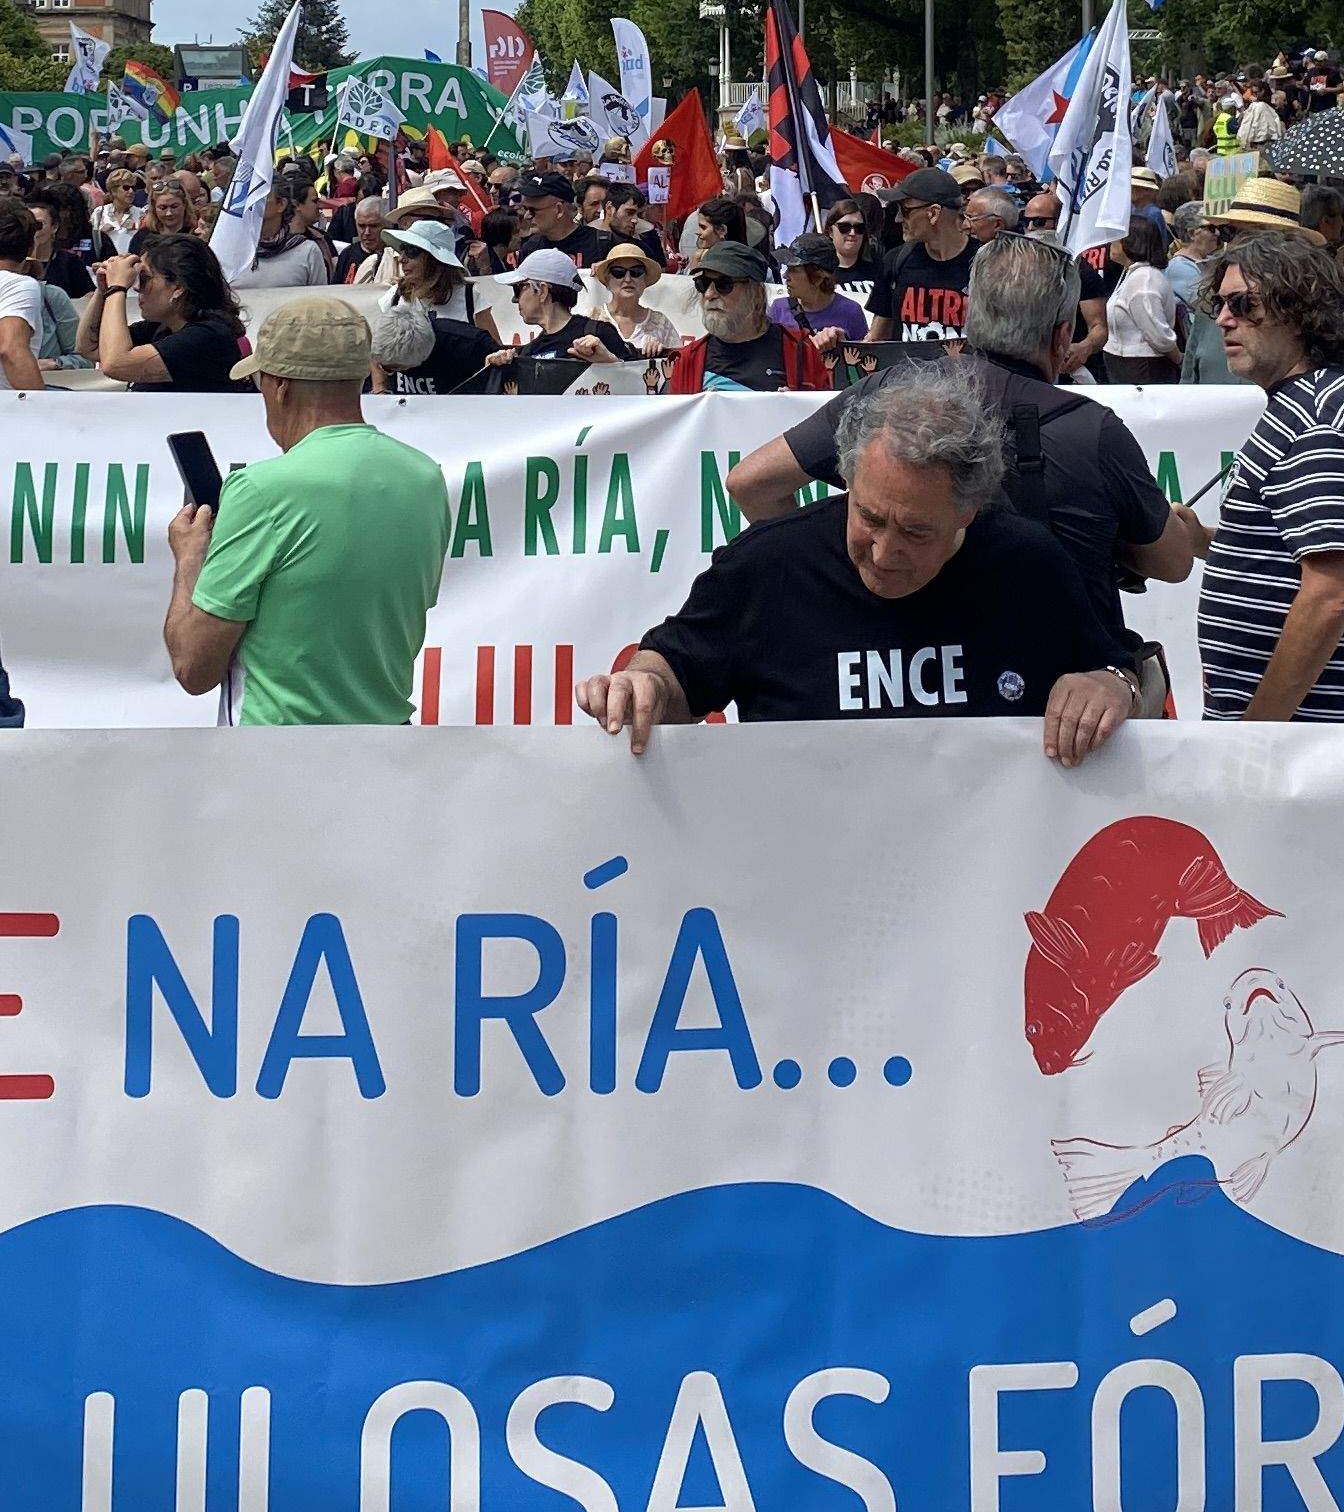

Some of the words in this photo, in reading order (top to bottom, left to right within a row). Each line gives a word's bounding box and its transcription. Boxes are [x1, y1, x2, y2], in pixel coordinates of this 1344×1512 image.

[396, 371, 437, 395] ENCE
[10, 462, 149, 564] NIN
[451, 461, 493, 559] A
[523, 424, 670, 573] RÍA,
[837, 644, 968, 711] ENCE
[123, 909, 387, 1099] NA
[453, 855, 914, 1097] RÍA...
